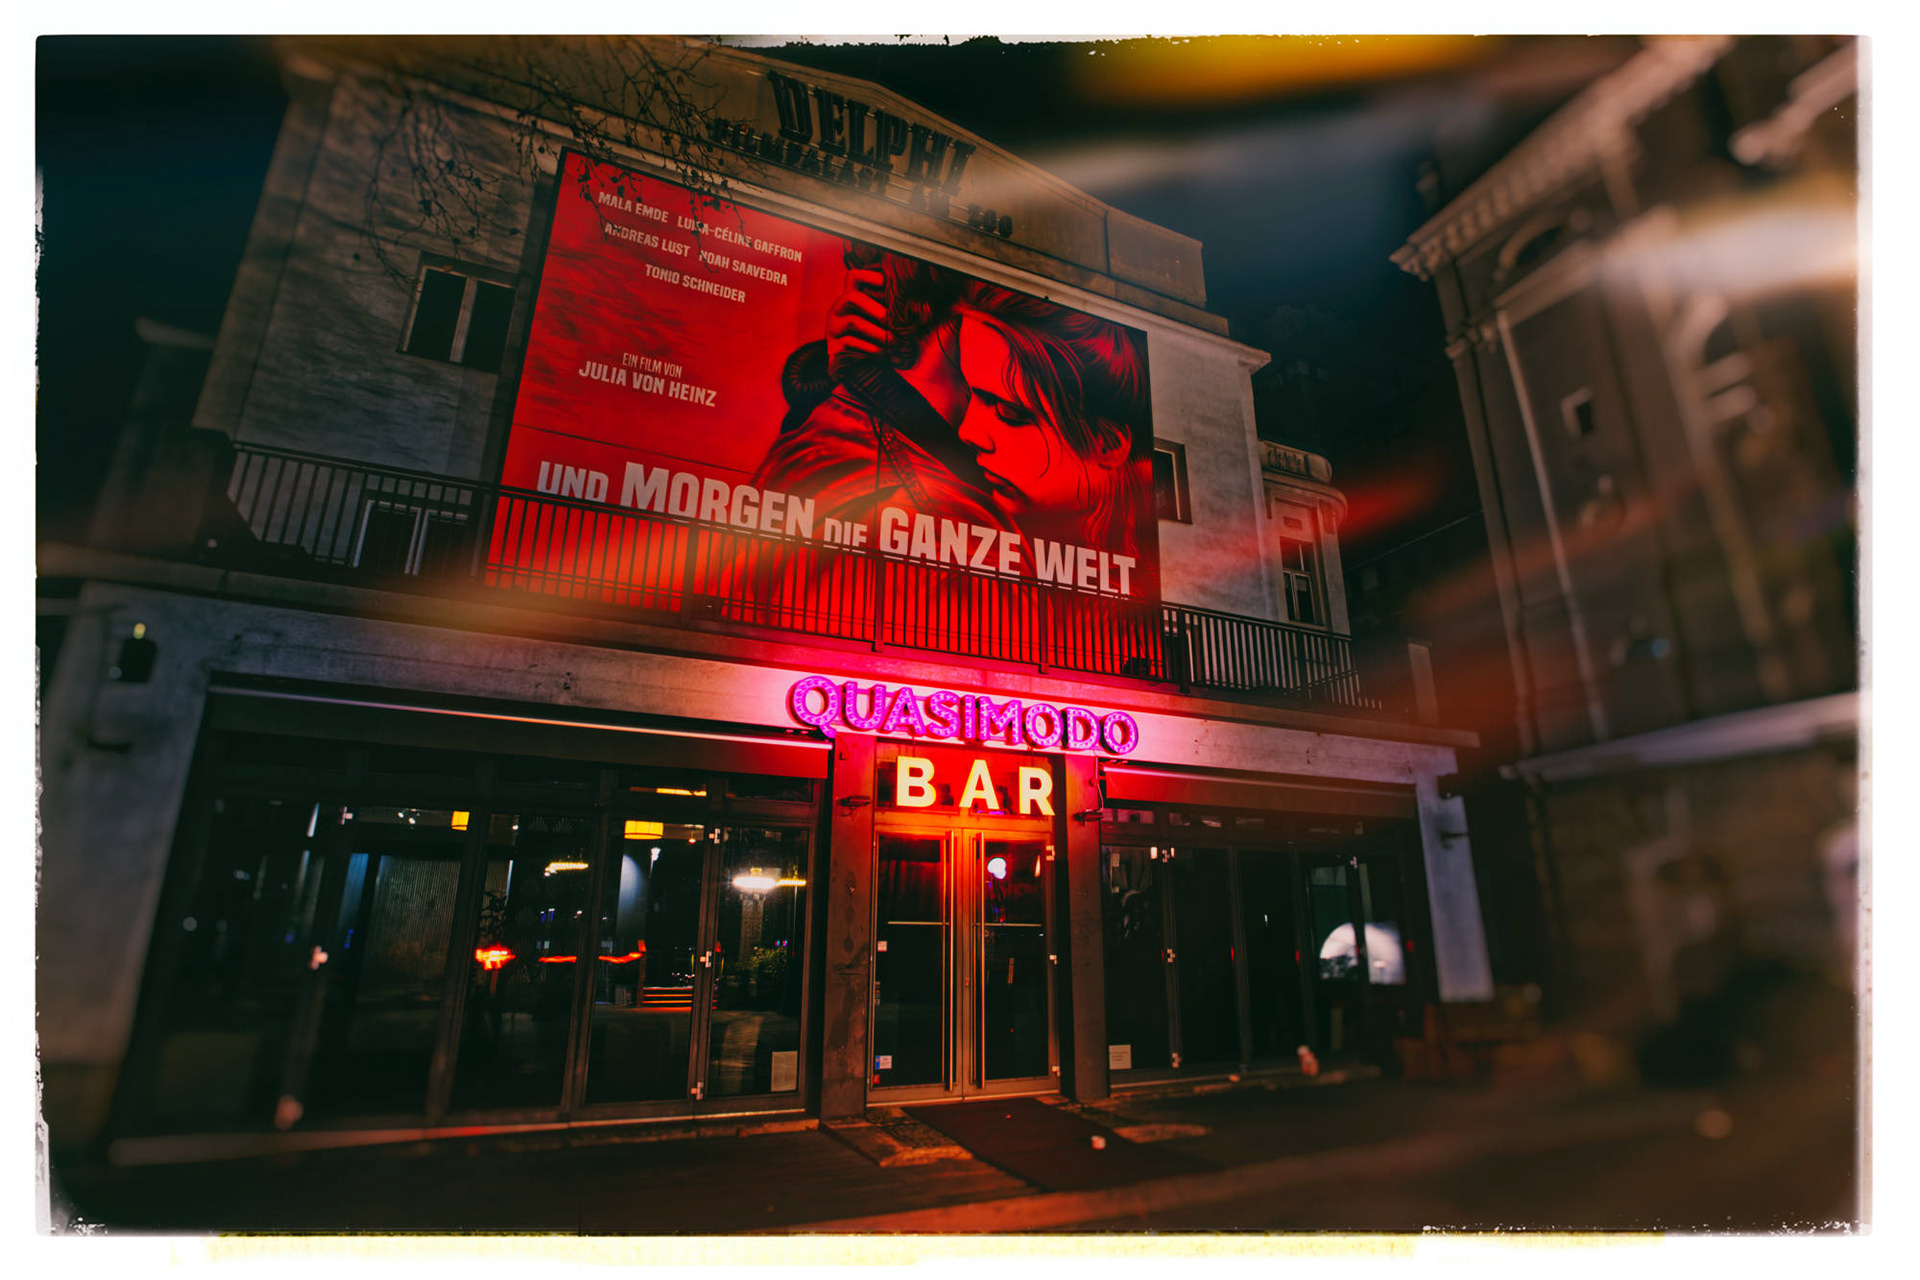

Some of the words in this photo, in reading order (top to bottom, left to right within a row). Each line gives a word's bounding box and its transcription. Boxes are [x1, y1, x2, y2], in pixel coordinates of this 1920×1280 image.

[767, 70, 976, 196] DELPHI
[598, 191, 632, 213] MALA
[635, 203, 669, 223] EMDE
[754, 239, 802, 263] GAFFRON
[968, 204, 1012, 239] ZOO
[605, 222, 659, 248] ANDREAS
[661, 238, 690, 257] LUST
[699, 250, 729, 269] NOAH
[732, 260, 788, 286] SAAVEDRA
[645, 264, 680, 285] TONIO
[682, 276, 746, 303] SCHNEIDER
[578, 361, 627, 387] JULIA
[632, 372, 665, 396] VON
[668, 381, 717, 407] HEINZ
[622, 352, 639, 368] EIN
[640, 356, 662, 374] FILM
[664, 363, 683, 379] VON
[537, 461, 609, 503] UND
[620, 461, 815, 544] MORGEN
[823, 517, 868, 553] DIE
[880, 506, 1021, 581] GANZE
[1034, 538, 1136, 600] WELT
[786, 675, 1139, 755] QUASIMODO
[896, 755, 1056, 816] BAR
